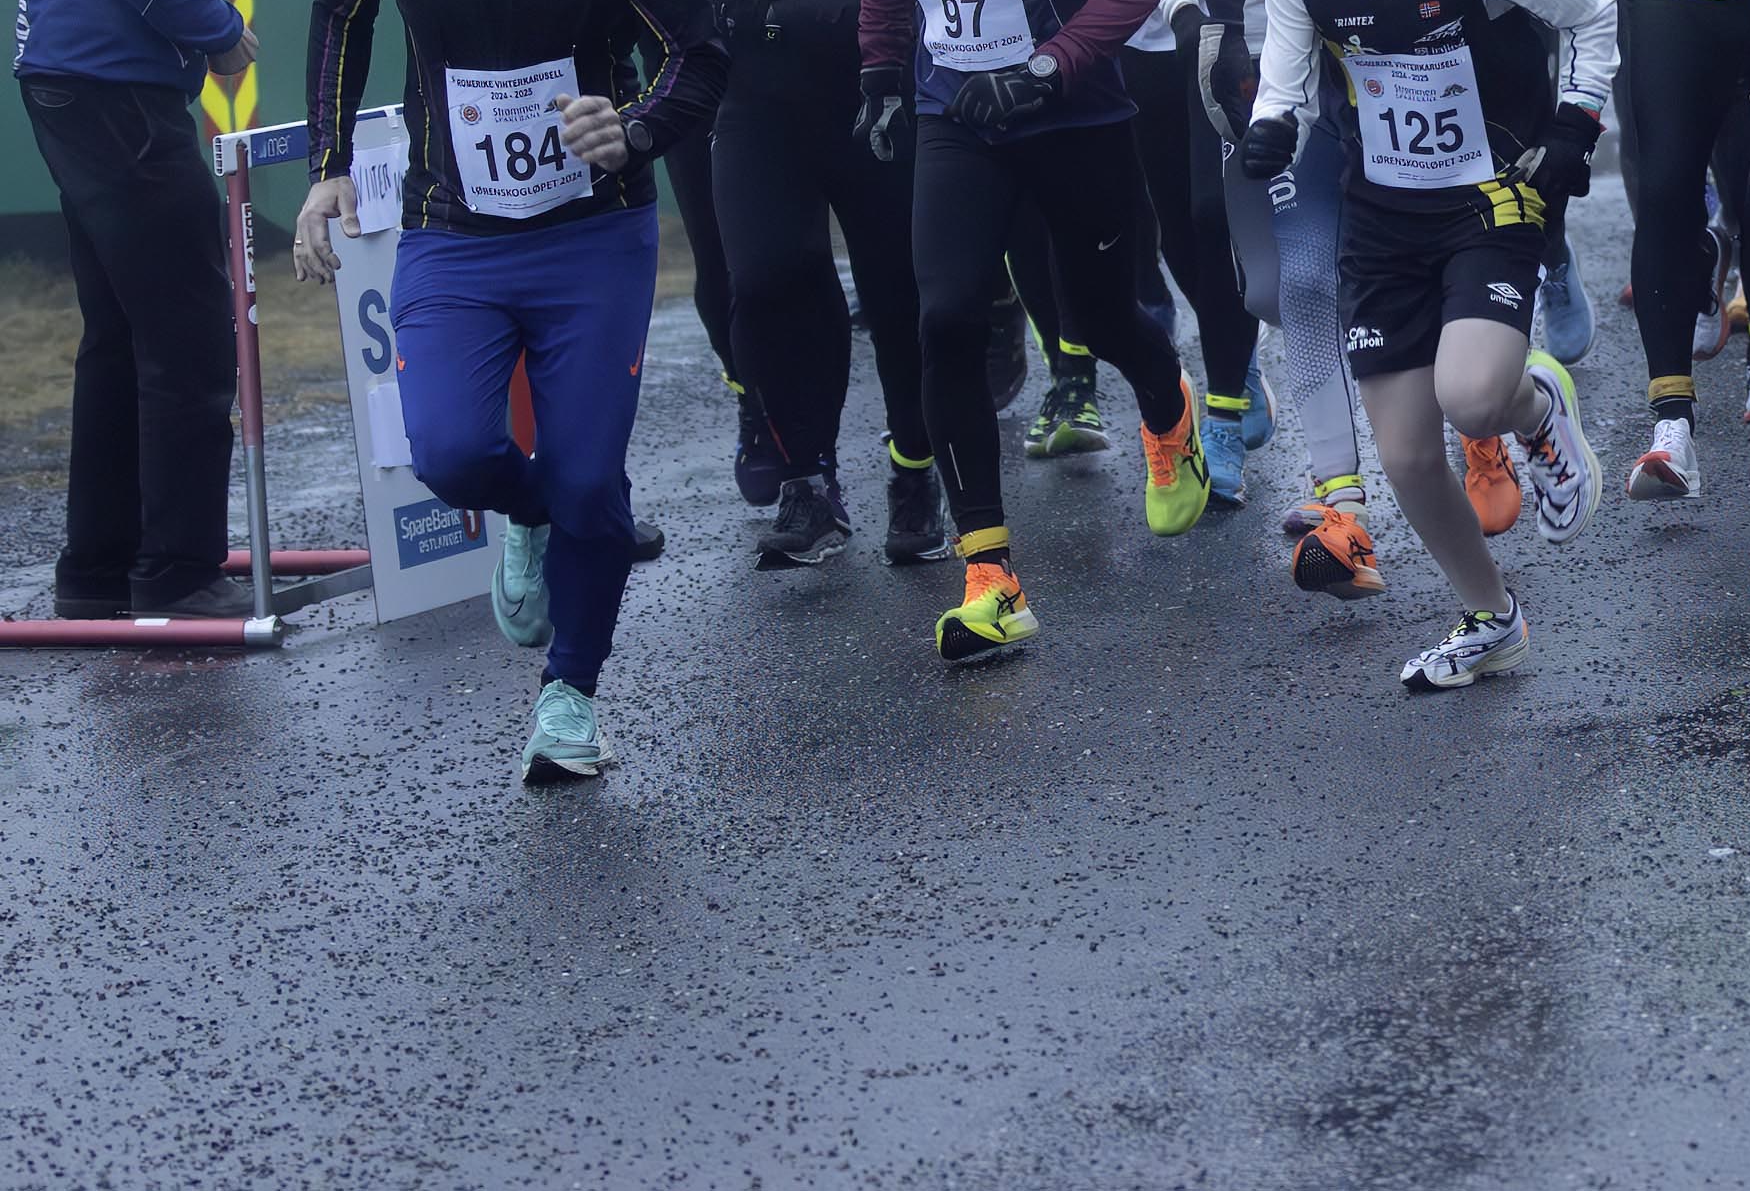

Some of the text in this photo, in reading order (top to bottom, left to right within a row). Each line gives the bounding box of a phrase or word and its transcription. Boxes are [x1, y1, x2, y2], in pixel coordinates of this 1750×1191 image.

[1334, 15, 1375, 28] RIMTEX
[1001, 34, 1023, 46] 2024
[490, 91, 508, 100] 2024
[514, 88, 533, 98] 2025
[1379, 107, 1464, 155] 125
[475, 125, 567, 182] 184
[1458, 150, 1482, 163] 2024
[471, 170, 583, 198] LØRENSKOGLØPET 2024
[400, 508, 461, 541] SpareBank
